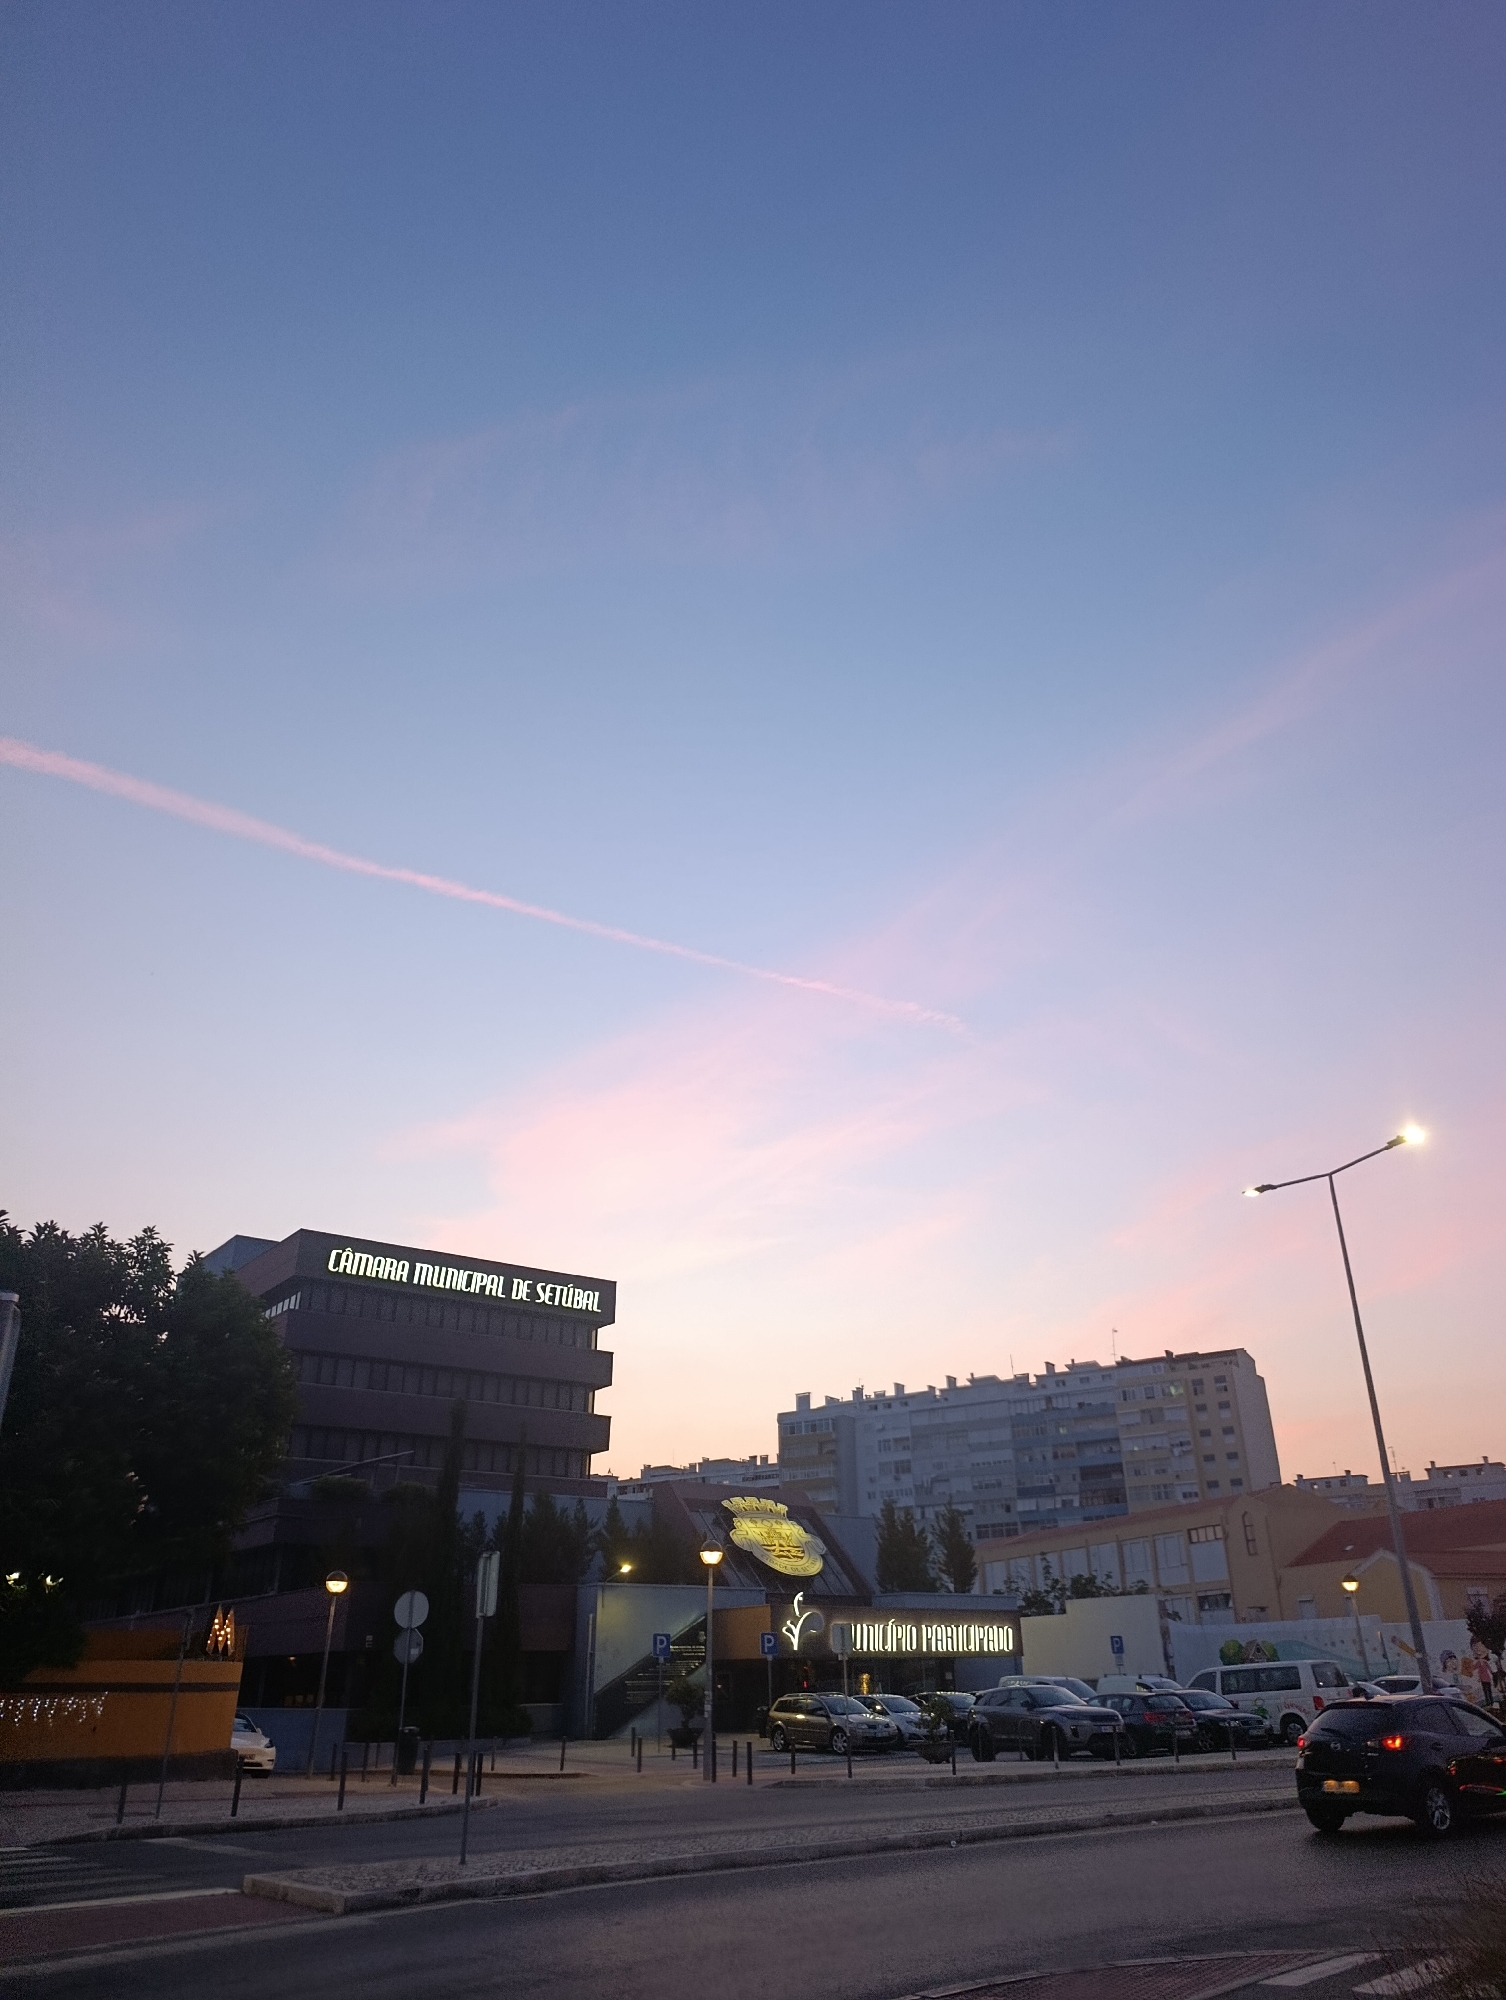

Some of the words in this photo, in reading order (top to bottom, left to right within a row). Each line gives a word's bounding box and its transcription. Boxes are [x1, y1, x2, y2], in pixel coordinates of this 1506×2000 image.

[327, 1247, 410, 1283] CÂMARA
[413, 1262, 506, 1298] MUNICIPAL
[511, 1278, 534, 1302] DE
[535, 1283, 602, 1313] SETÚBAL
[656, 1635, 667, 1654] P
[764, 1634, 775, 1653] P
[851, 1618, 917, 1652] UNICÍPIO
[1112, 1637, 1121, 1652] P
